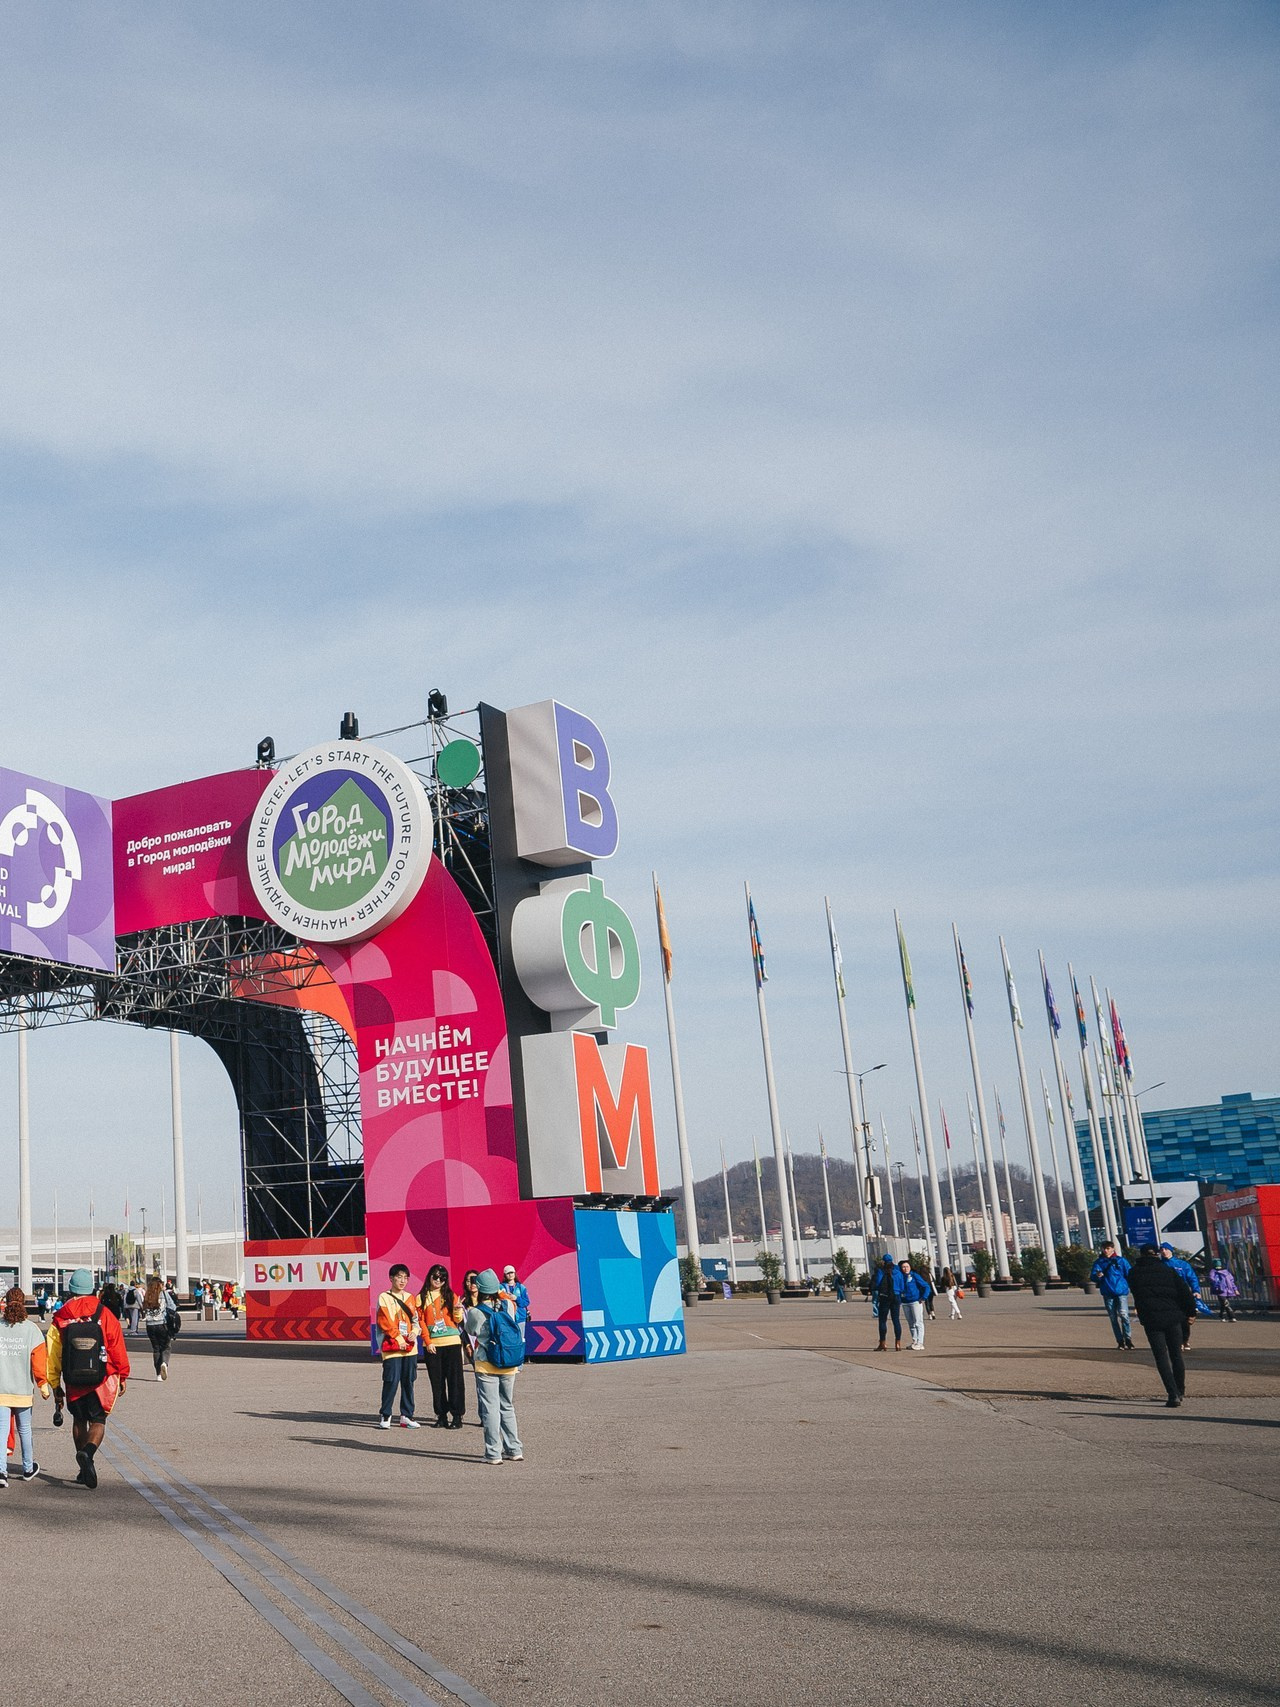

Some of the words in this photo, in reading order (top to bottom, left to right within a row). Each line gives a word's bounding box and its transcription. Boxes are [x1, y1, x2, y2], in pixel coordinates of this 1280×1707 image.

[328, 750, 370, 766] START
[372, 759, 395, 784] THE
[256, 785, 287, 848] ВМЕСТЕ!
[391, 783, 412, 844] FUTURE
[126, 836, 162, 854] Добро
[164, 820, 232, 843] пожаловать
[128, 858, 135, 867] в
[137, 849, 171, 865] Город
[173, 835, 232, 857] молодёжи
[162, 858, 196, 875] мира!
[256, 853, 292, 916] БУДУЩЕЕ
[357, 850, 410, 921] TOGETHER
[292, 912, 348, 931] НАЧНЕМ
[375, 1024, 472, 1058] НАЧНЁМ
[376, 1051, 489, 1084] БУДУЩЕЕ
[377, 1078, 479, 1108] ВМЕСТЕ!
[316, 1261, 368, 1282] WYF
